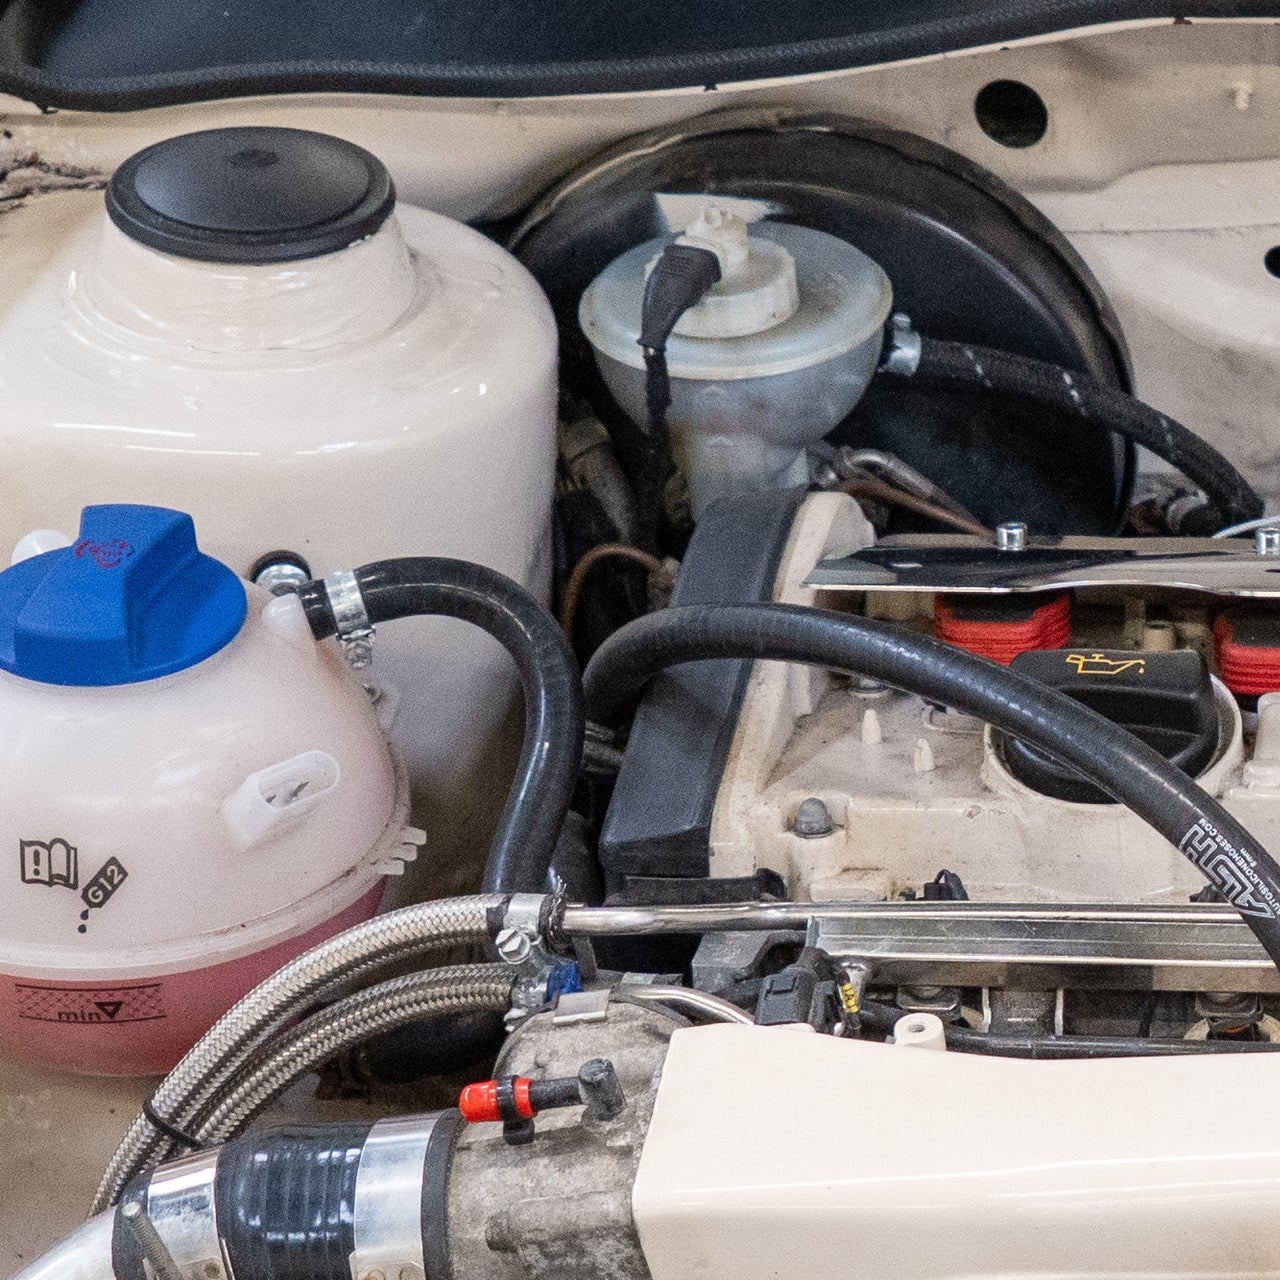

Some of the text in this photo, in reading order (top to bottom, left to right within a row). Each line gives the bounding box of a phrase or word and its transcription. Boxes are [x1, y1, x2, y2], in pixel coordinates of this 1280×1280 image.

[86, 864, 123, 903] G12
[1179, 824, 1276, 918] ASH
[57, 1009, 101, 1022] min
